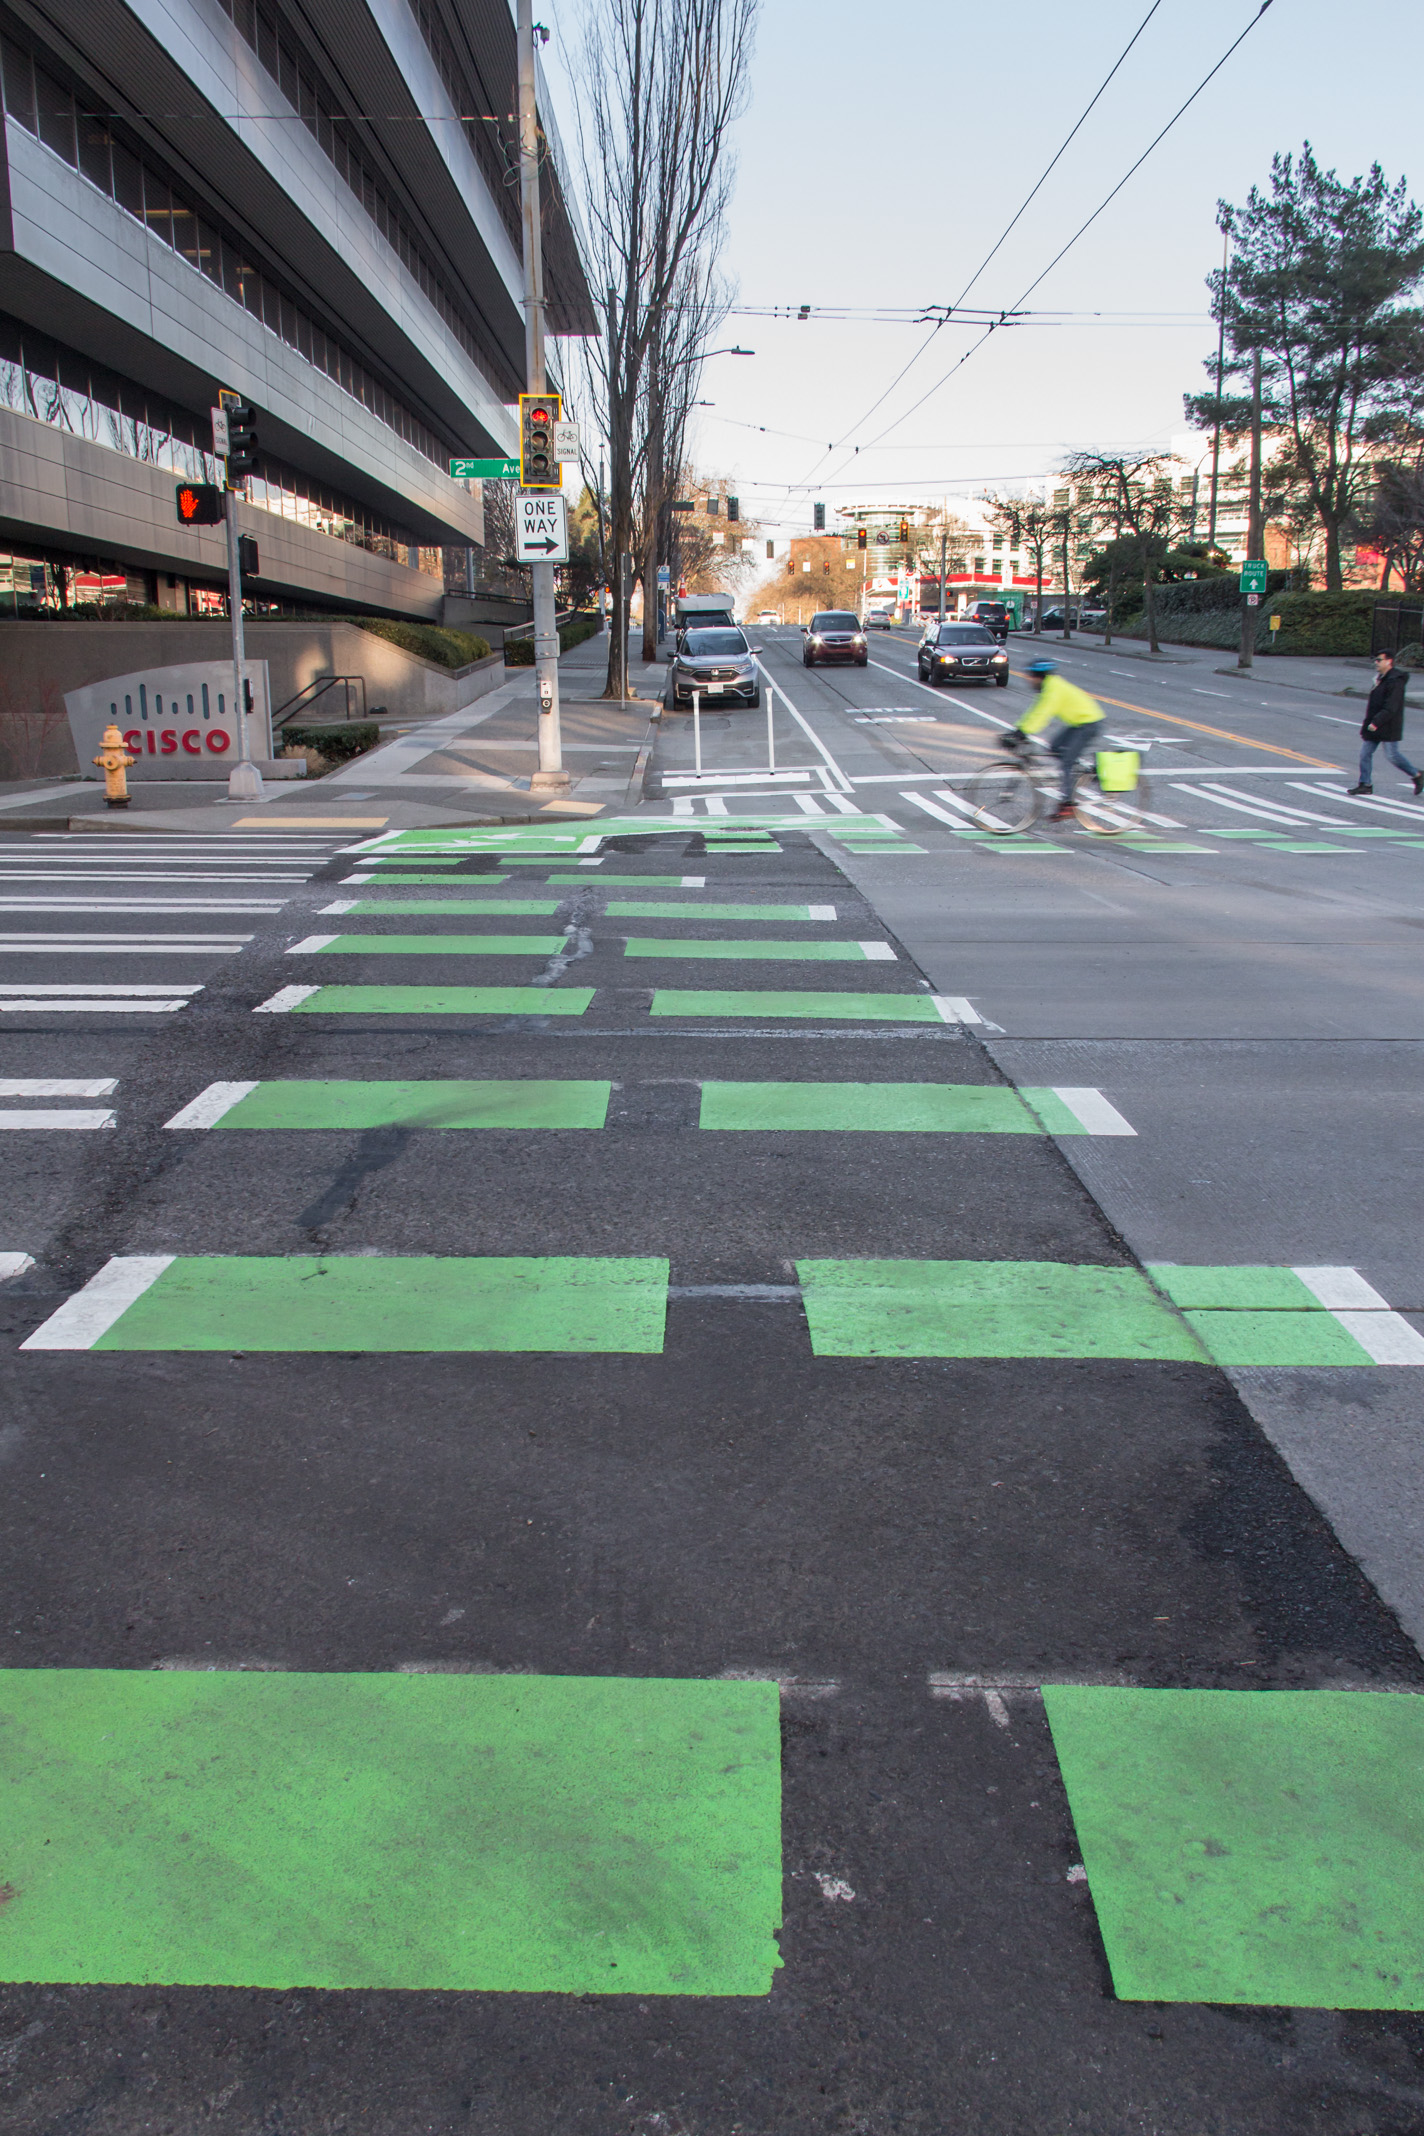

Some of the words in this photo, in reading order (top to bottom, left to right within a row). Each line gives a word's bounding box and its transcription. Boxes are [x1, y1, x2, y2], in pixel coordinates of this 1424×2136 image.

[455, 461, 474, 476] 2nd
[524, 501, 556, 515] ONE
[524, 518, 558, 533] WAY
[123, 729, 231, 753] CISCO
